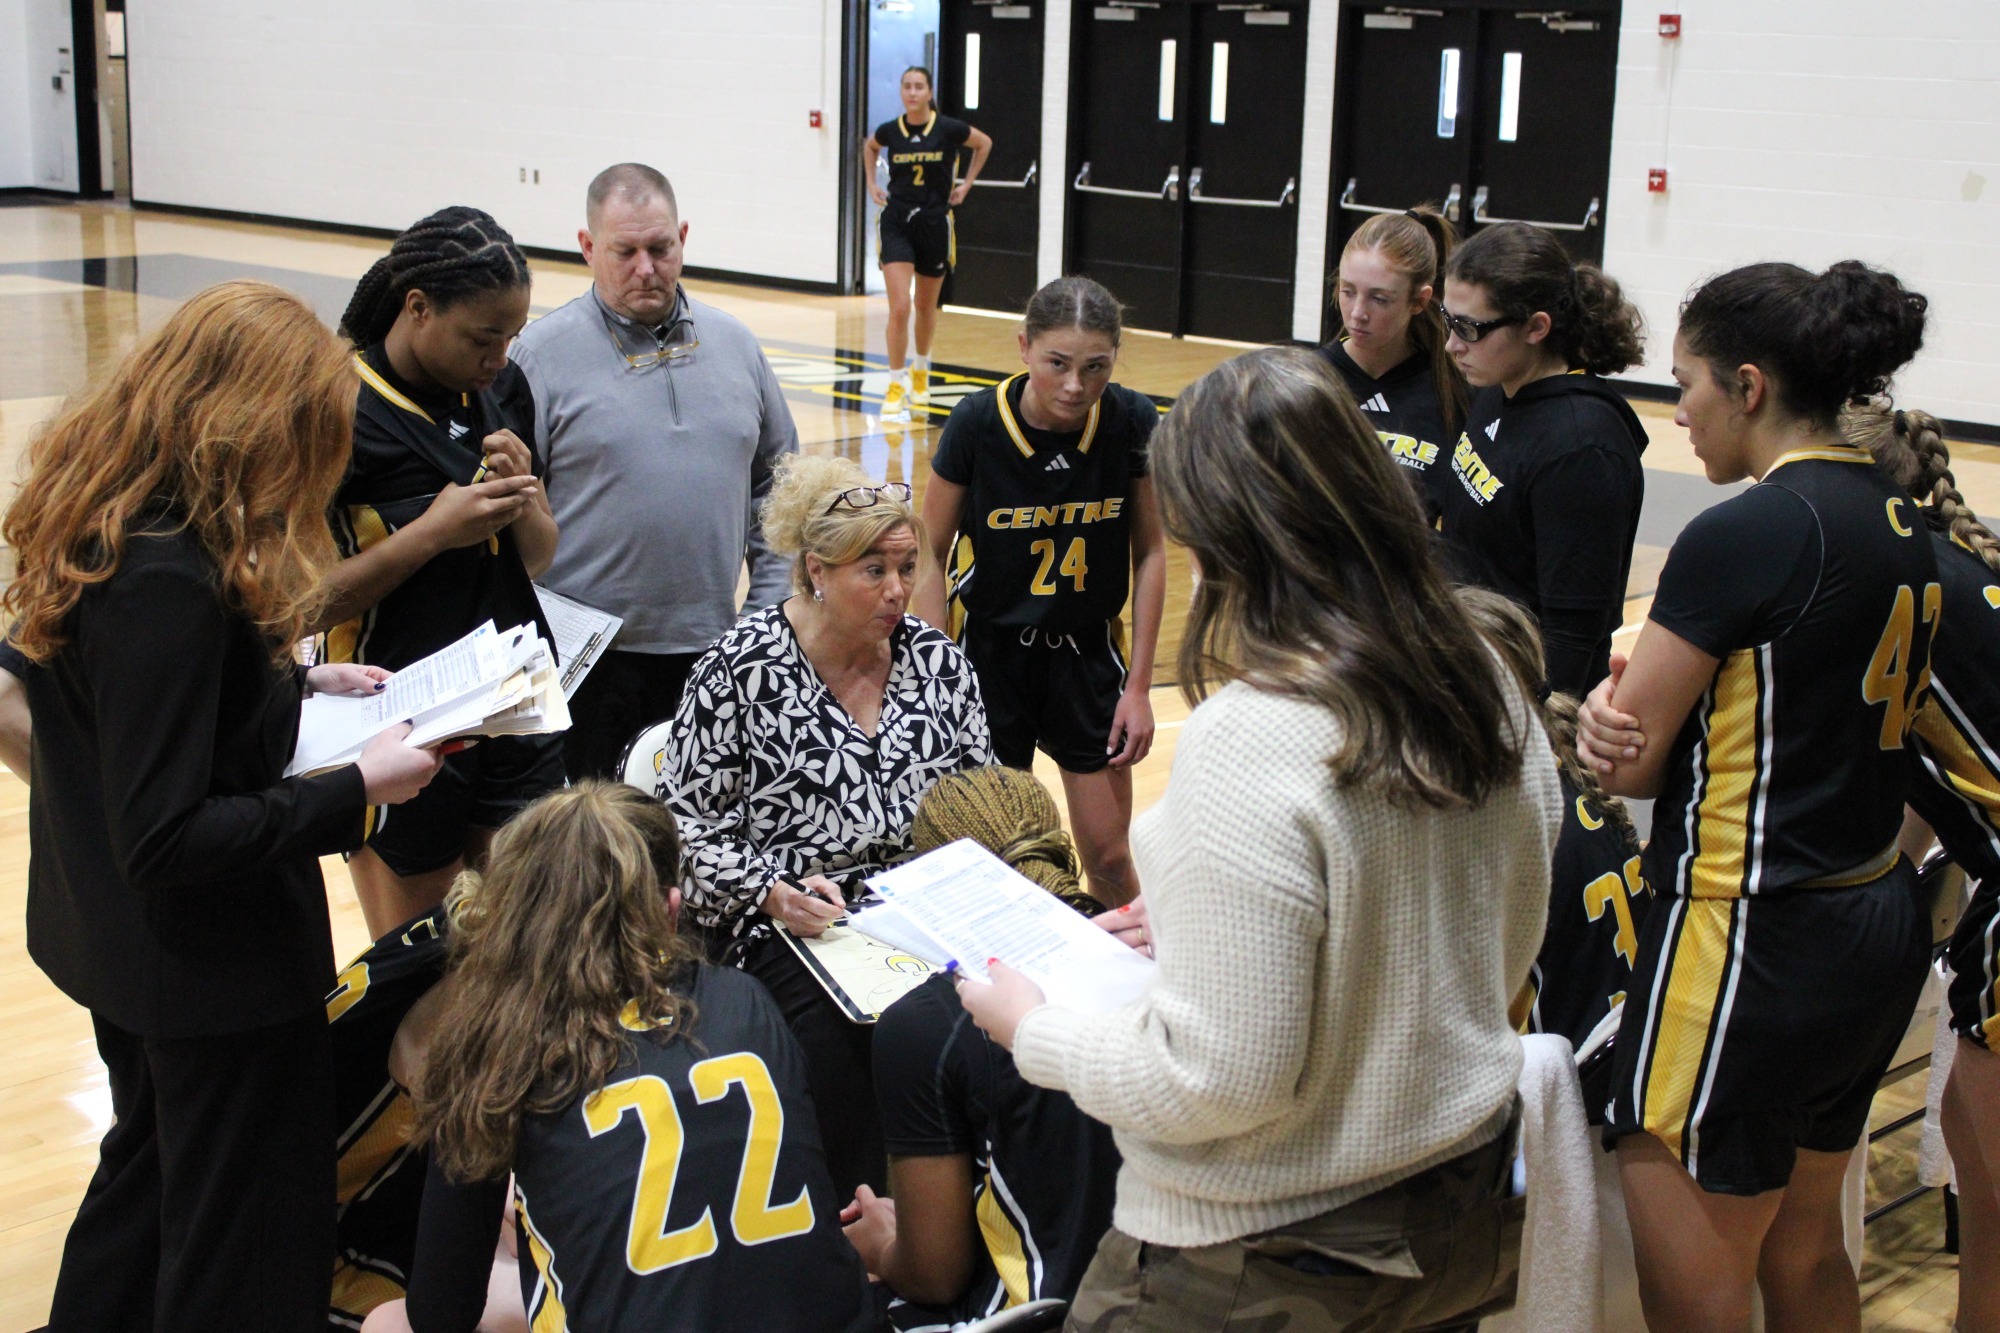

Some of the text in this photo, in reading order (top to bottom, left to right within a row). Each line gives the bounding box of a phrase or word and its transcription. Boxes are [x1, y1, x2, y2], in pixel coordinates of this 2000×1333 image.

[893, 151, 943, 164] CENTRE
[912, 164, 925, 186] 2
[1375, 430, 1440, 465] TRE
[986, 497, 1125, 530] CENTRE
[1885, 497, 1913, 537] C
[1030, 537, 1089, 596] 24
[581, 1051, 815, 1276] 22
